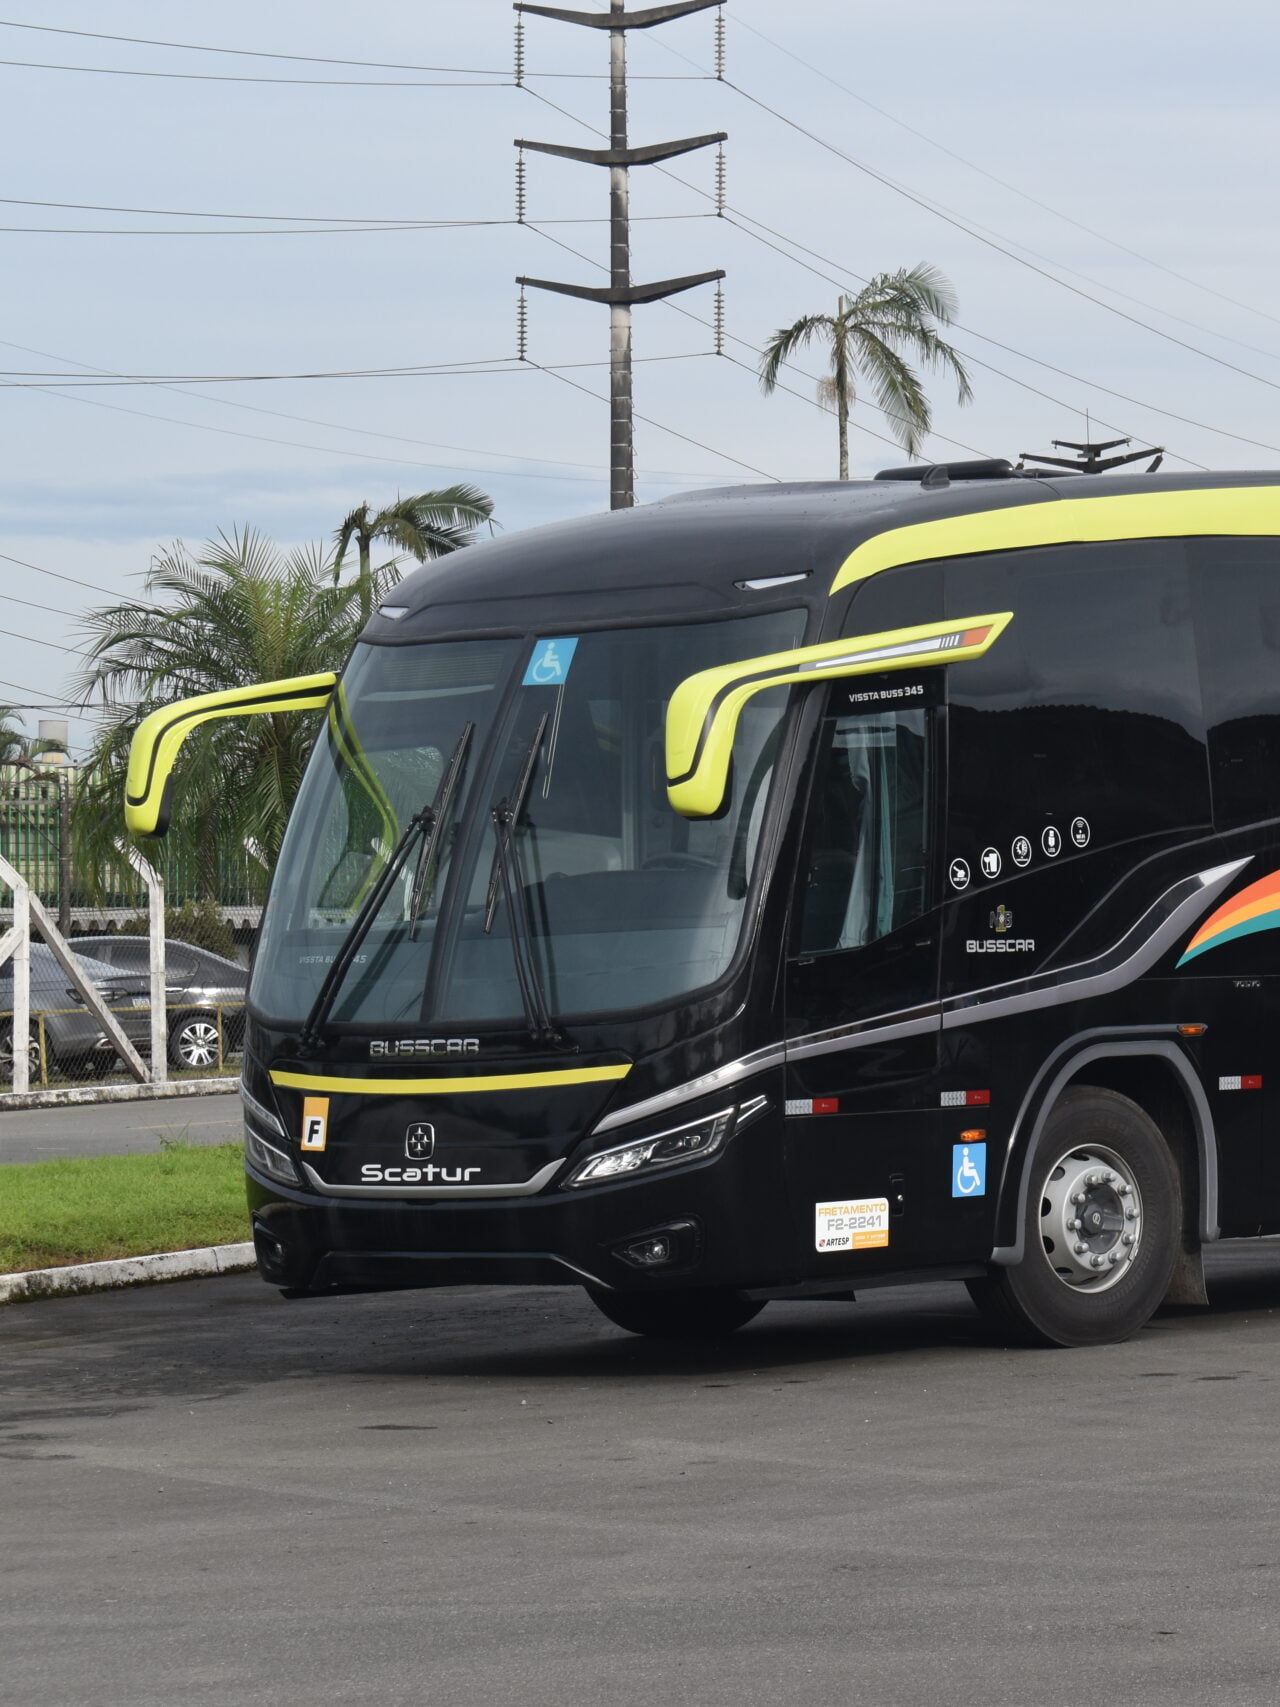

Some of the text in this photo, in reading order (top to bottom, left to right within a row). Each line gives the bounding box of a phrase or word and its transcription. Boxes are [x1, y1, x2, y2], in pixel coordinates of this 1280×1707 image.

[849, 685, 924, 703] VISSTA BUSS 345
[966, 939, 1035, 953] BUSSCAR
[369, 1038, 480, 1057] BUSSCAR
[307, 1120, 321, 1143] F
[361, 1163, 481, 1182] Scatur
[818, 1203, 887, 1217] FRETAMENTO
[827, 1214, 882, 1231] F2-2241
[826, 1237, 850, 1247] ARTESP
